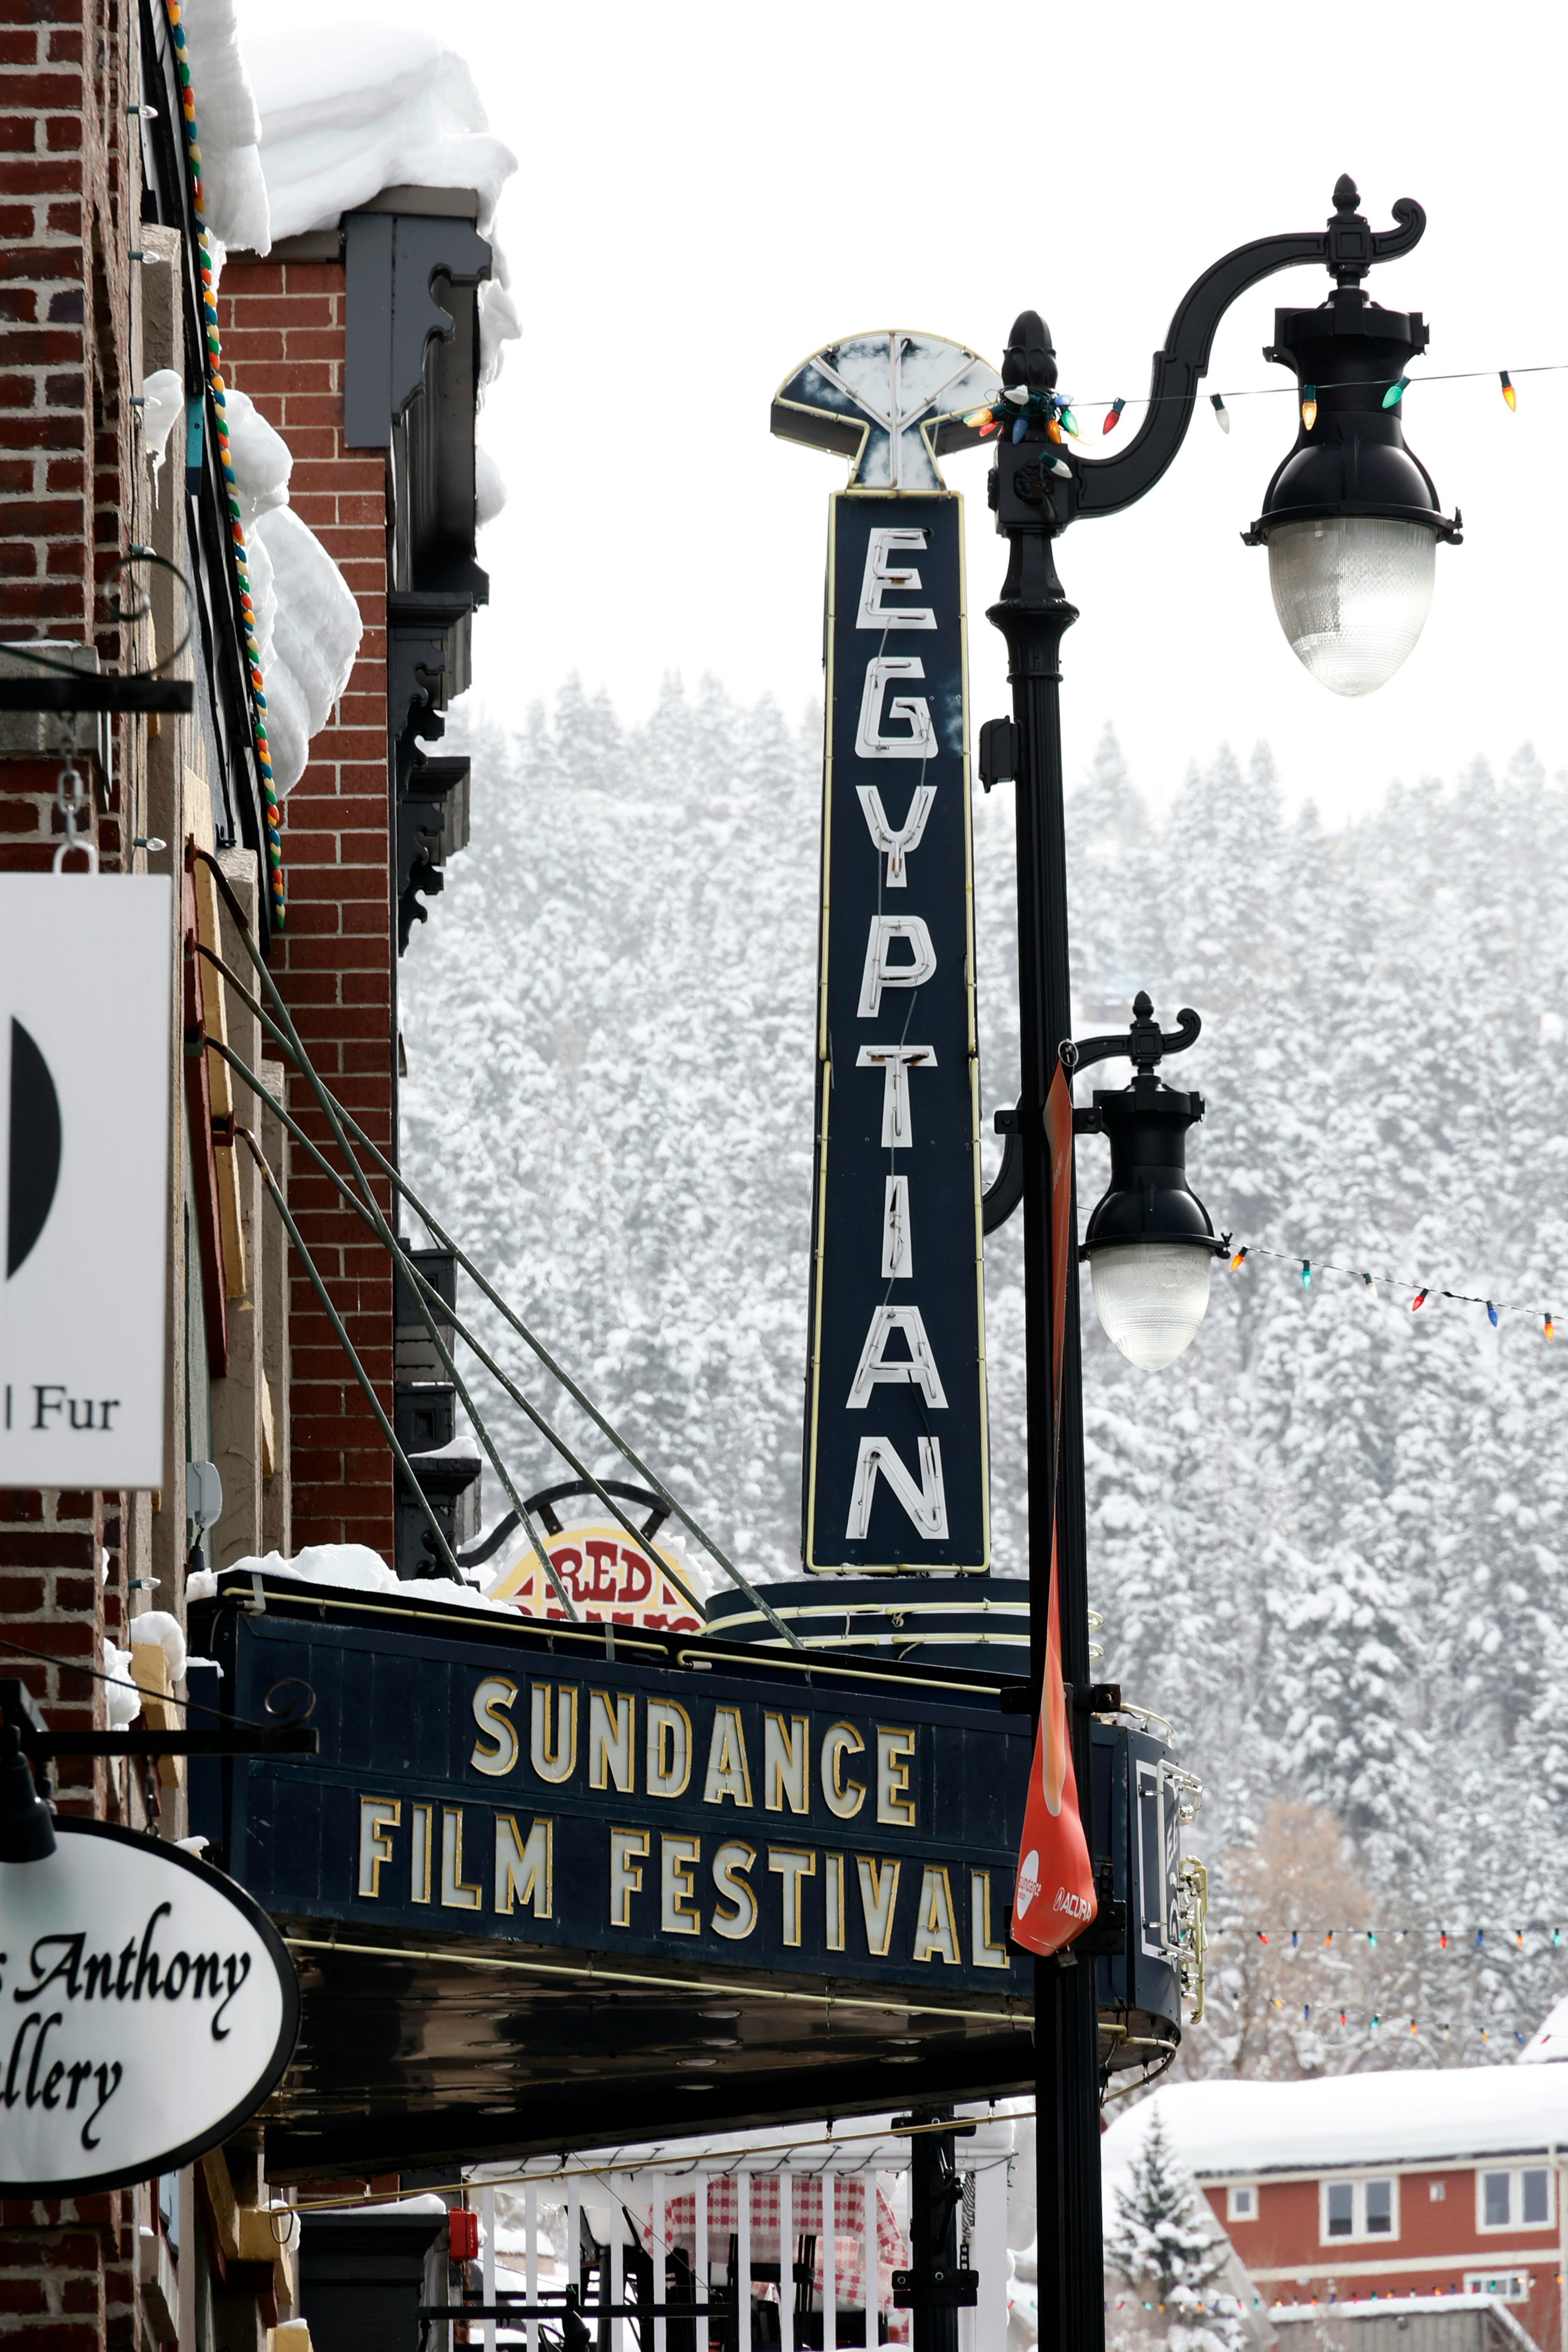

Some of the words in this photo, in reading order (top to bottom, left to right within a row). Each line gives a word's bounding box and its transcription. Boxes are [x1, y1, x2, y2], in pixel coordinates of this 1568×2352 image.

[846, 527, 950, 1540] EGYPTIAN
[31, 1385, 121, 1430] Fur
[546, 1540, 652, 1602] RED
[470, 1676, 915, 1827] SUNDANCE
[358, 1795, 552, 1919] FILM
[610, 1826, 1010, 1969] FESTIVAL
[1059, 1891, 1091, 1923] ACURA
[13, 1901, 251, 2041] Anthony
[0, 2012, 123, 2150] llery
